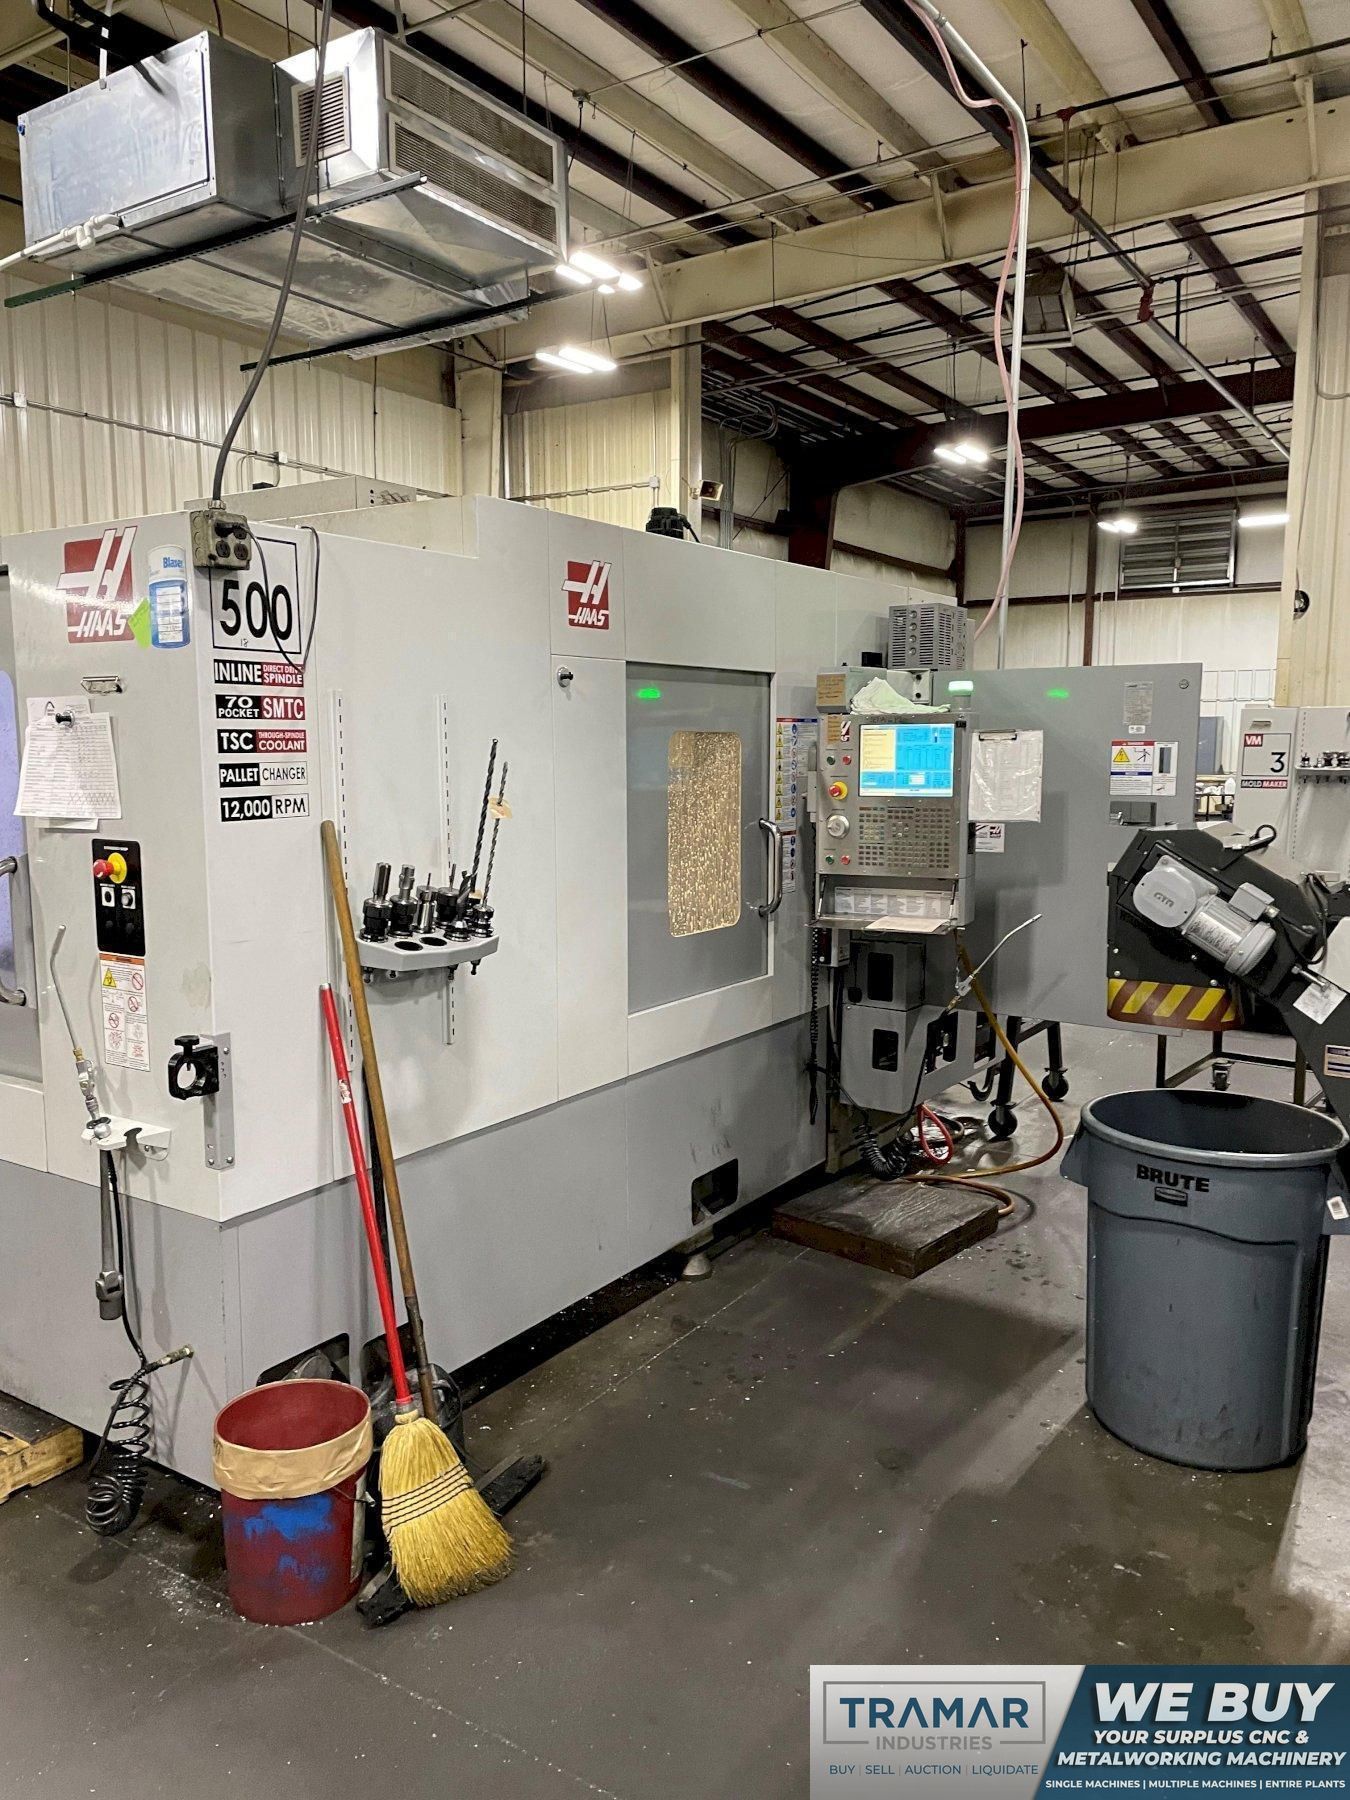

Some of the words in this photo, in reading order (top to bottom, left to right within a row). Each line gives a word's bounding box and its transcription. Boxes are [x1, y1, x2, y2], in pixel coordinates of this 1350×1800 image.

[220, 579, 292, 641] 500
[568, 607, 609, 626] HAAS
[67, 609, 133, 638] HAAS
[214, 662, 262, 683] INLINE
[263, 664, 284, 673] DIRECT
[263, 673, 303, 685] SPINDLE
[225, 696, 253, 708] 70
[263, 697, 303, 719] SMTC
[218, 708, 260, 718] POCKET
[220, 732, 254, 750] TSC
[258, 731, 304, 739] THROUGH-SPINDLE
[1246, 736, 1261, 745] VM
[258, 740, 305, 751] COOLANT
[1270, 751, 1287, 773] 3
[220, 767, 259, 782] PALLET
[262, 767, 306, 781] CHANGER
[222, 799, 271, 819] 12,000
[275, 797, 306, 815] RPM
[1136, 1163, 1210, 1193] BRUTE
